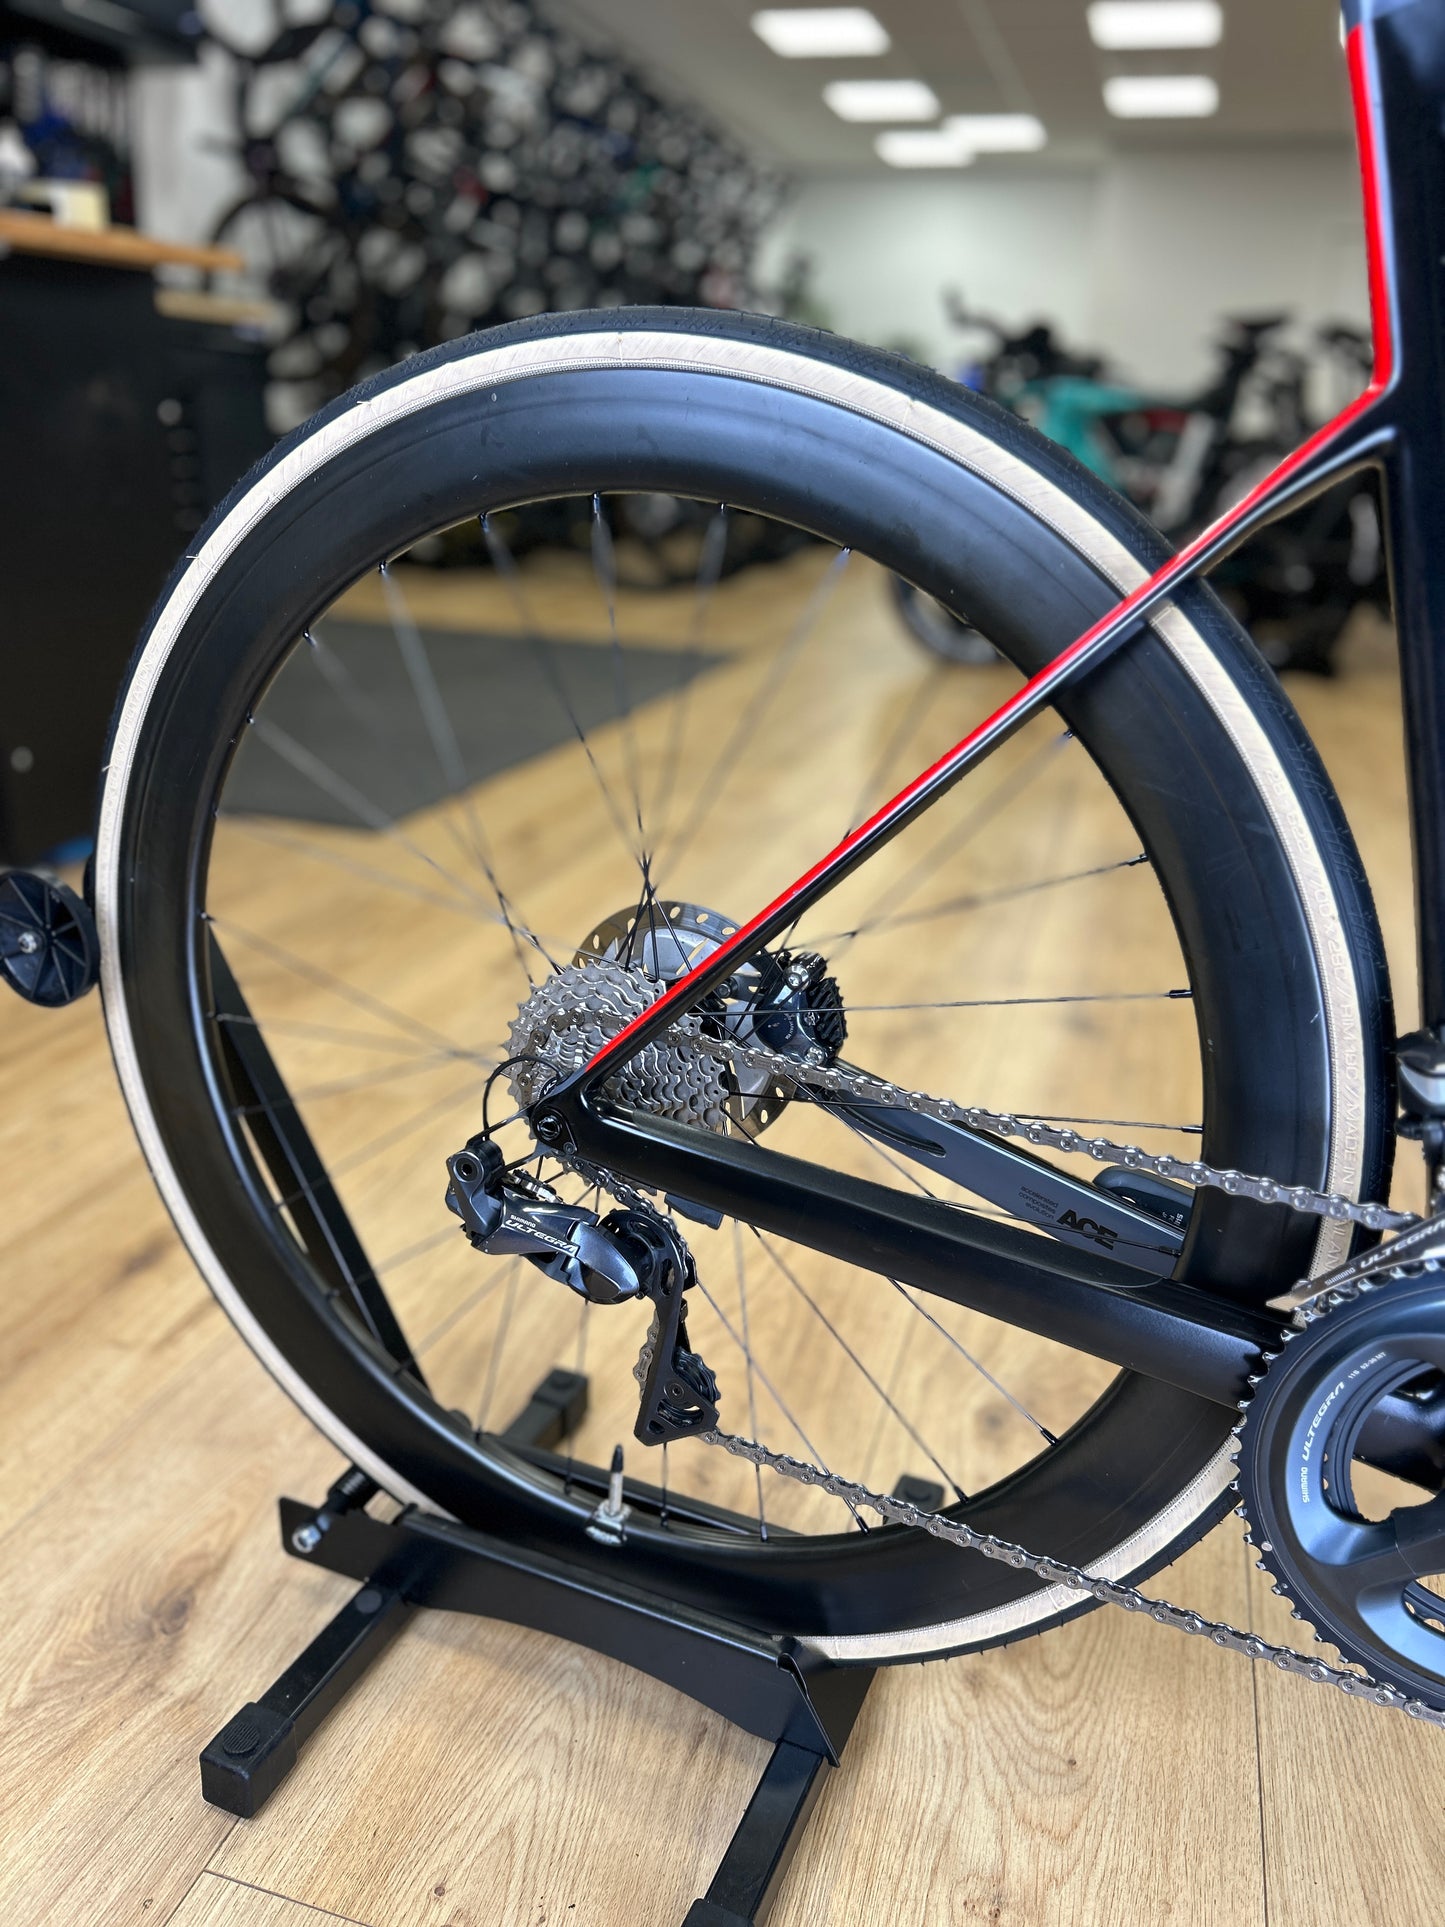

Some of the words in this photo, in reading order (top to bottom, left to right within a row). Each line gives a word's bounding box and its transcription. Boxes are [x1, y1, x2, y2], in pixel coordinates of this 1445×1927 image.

[1338, 1003, 1357, 1042] RIM
[1343, 1104, 1360, 1161] MADE
[1342, 1166, 1355, 1185] IN
[1018, 1192, 1056, 1214] composites
[1025, 1201, 1054, 1219] evolution
[510, 1214, 536, 1228] SHIMANO
[1056, 1208, 1118, 1251] ACE
[505, 1219, 578, 1254] ULTEGRA
[1324, 1267, 1356, 1286] SHIMANO
[1301, 1382, 1345, 1462] ULTEGRA
